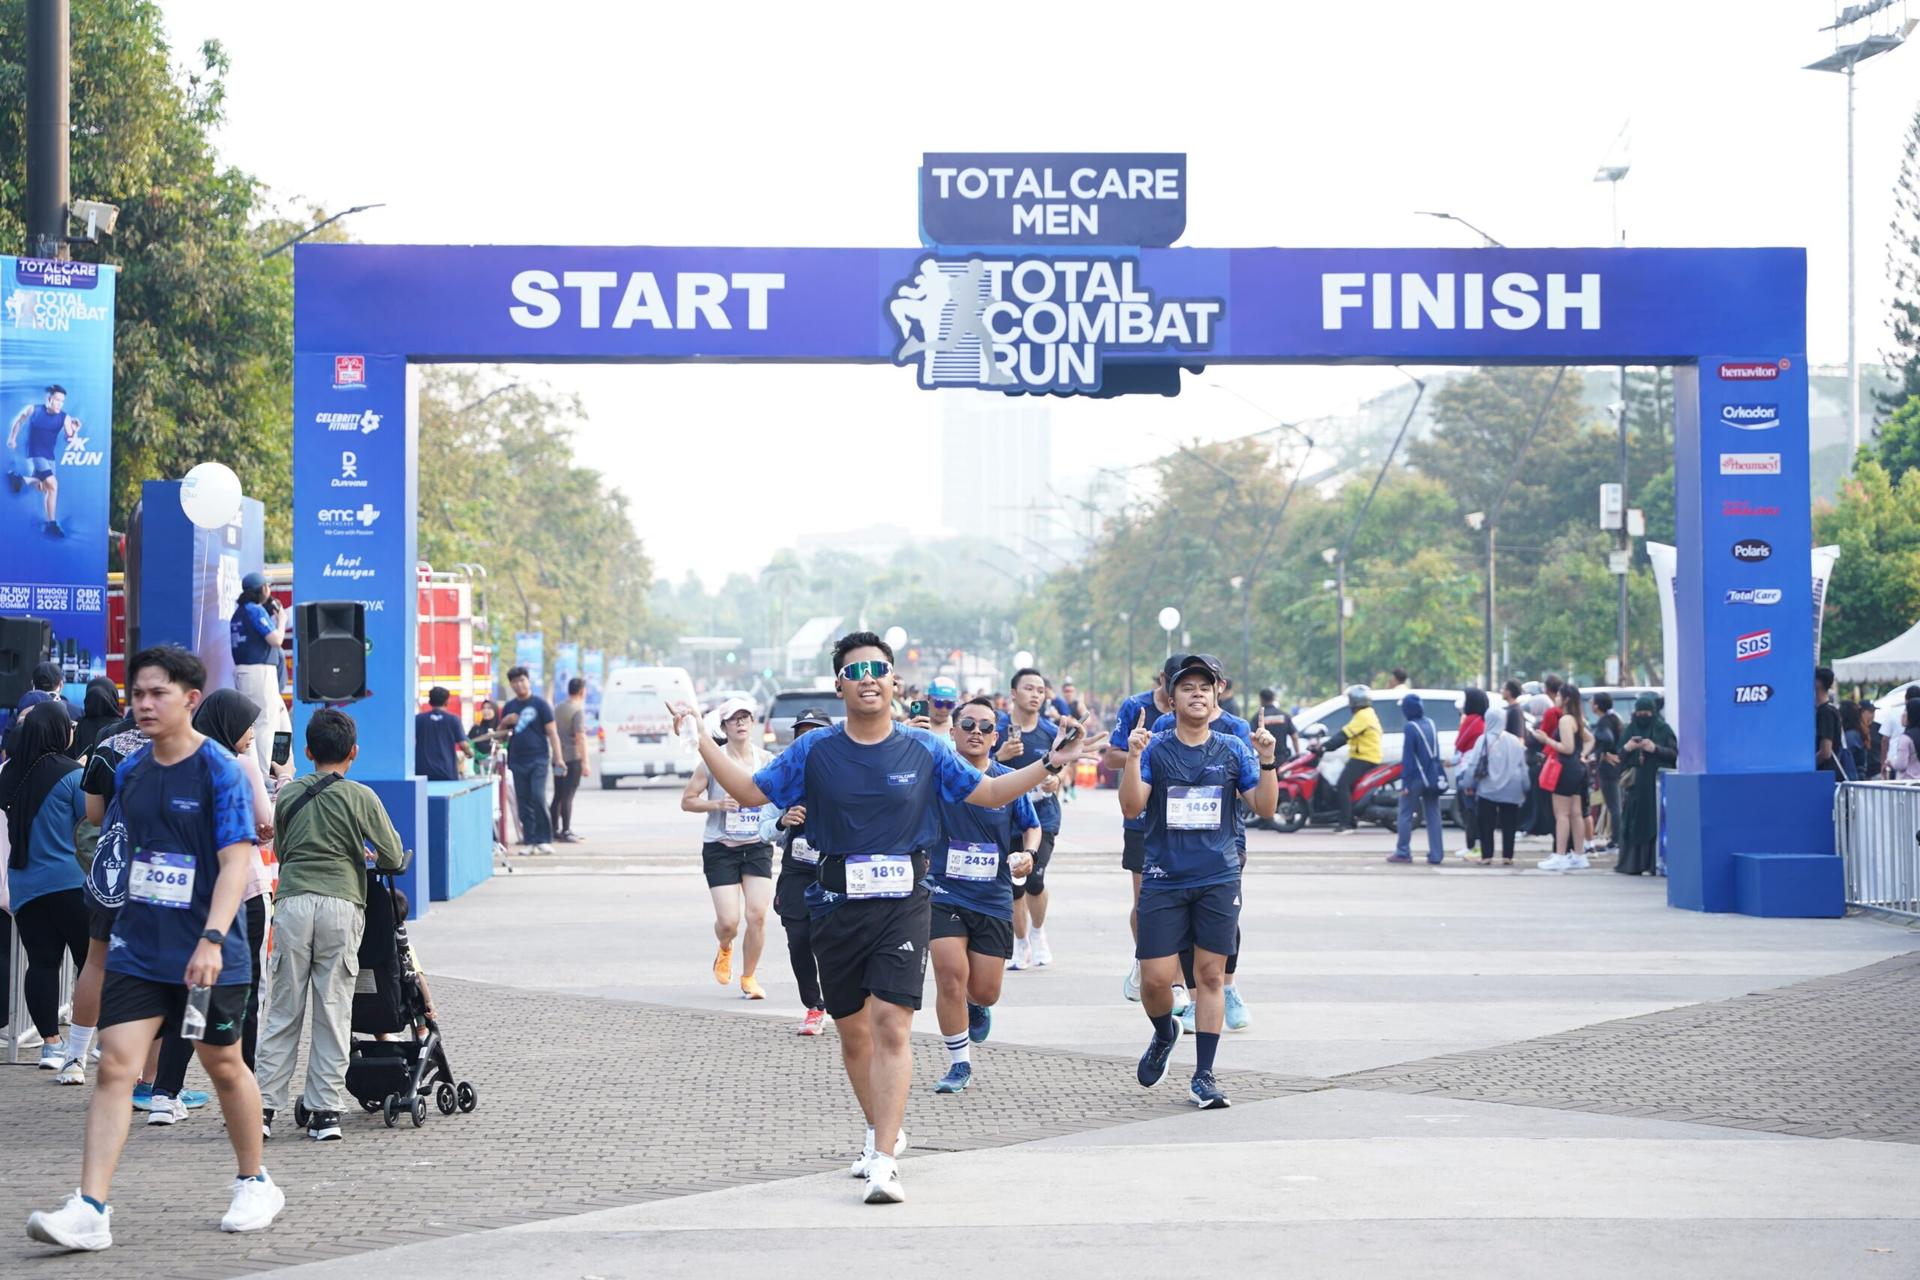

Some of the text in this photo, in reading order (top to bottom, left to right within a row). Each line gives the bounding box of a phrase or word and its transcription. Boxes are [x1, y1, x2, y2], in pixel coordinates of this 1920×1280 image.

[932, 168, 1179, 199] TOTAL CARE
[1013, 204, 1098, 235] MEN
[19, 260, 96, 277] TOTAL CARE
[43, 274, 71, 286] MEN
[983, 260, 1149, 303] TOTAL
[34, 291, 86, 307] TOTAL
[509, 269, 785, 330] START
[1321, 272, 1601, 330] FINISH
[33, 303, 108, 321] COMBAT
[32, 315, 70, 331] RUN
[986, 301, 1220, 344] COMBAT
[987, 343, 1095, 385] RUN
[1721, 366, 1777, 377] hemaviton
[315, 412, 362, 423] CELEBRITY
[1723, 406, 1775, 418] Oskadon
[328, 422, 358, 431] FITNESS
[64, 437, 90, 451] 7K
[60, 451, 103, 466] RUN
[1731, 459, 1778, 471] rheumacyl
[318, 509, 354, 522] emc
[1734, 545, 1770, 557] Polaris
[322, 563, 375, 580] kenangan
[0, 593, 30, 602] BODY
[76, 588, 101, 598] GBK
[36, 599, 68, 610] 2025
[76, 597, 101, 605] PLAZA
[1736, 686, 1768, 703] TAGS
[1186, 801, 1217, 812] 1469
[964, 855, 995, 866] 2434
[146, 869, 188, 885] 2068
[871, 866, 905, 878] 1819
